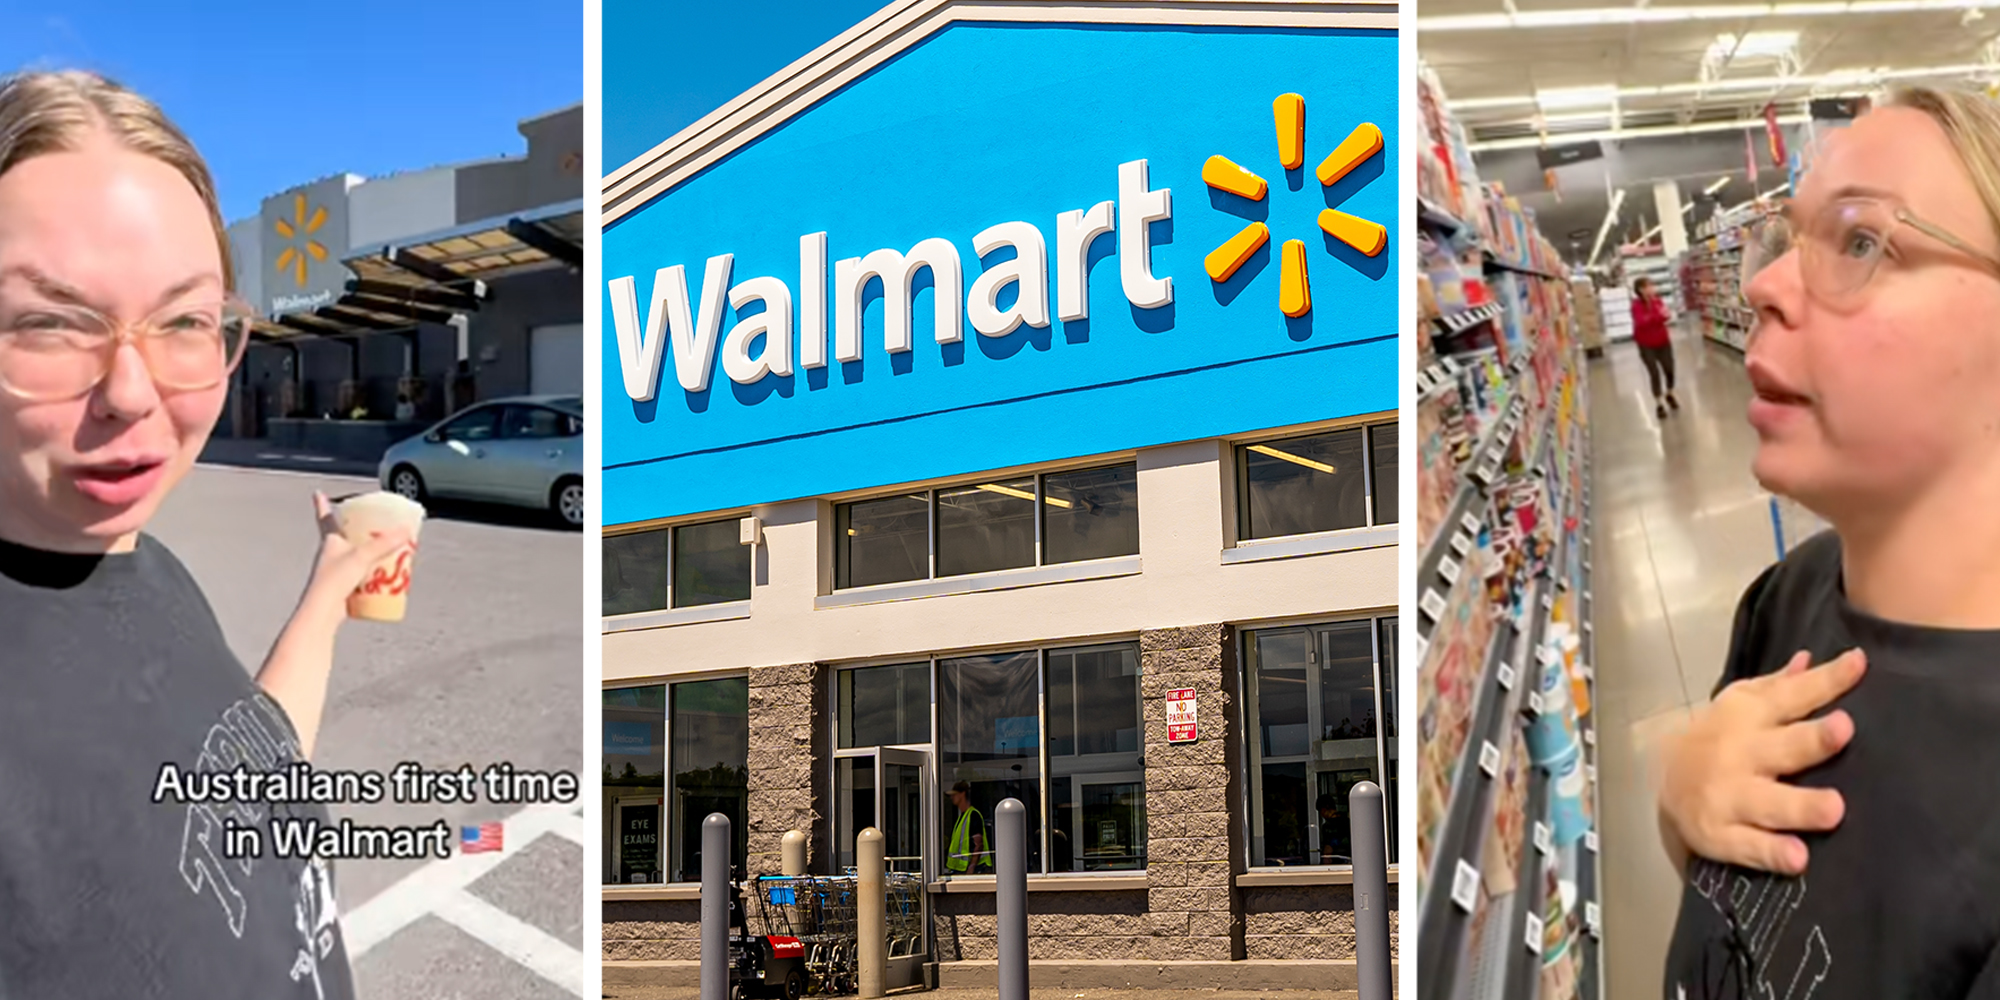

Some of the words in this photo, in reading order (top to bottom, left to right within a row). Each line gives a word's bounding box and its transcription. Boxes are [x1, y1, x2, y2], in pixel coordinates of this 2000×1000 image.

[608, 158, 1172, 403] Walmart
[1168, 691, 1179, 700] FIRE
[1181, 690, 1194, 699] LANE
[1176, 702, 1187, 712] NO
[1168, 711, 1195, 723] PARKING
[1170, 725, 1194, 733] TOW-AWAY
[611, 733, 644, 744] Welcome
[1175, 732, 1189, 740] ZONE
[631, 819, 649, 830] EYE
[623, 833, 657, 845] EXAMS
